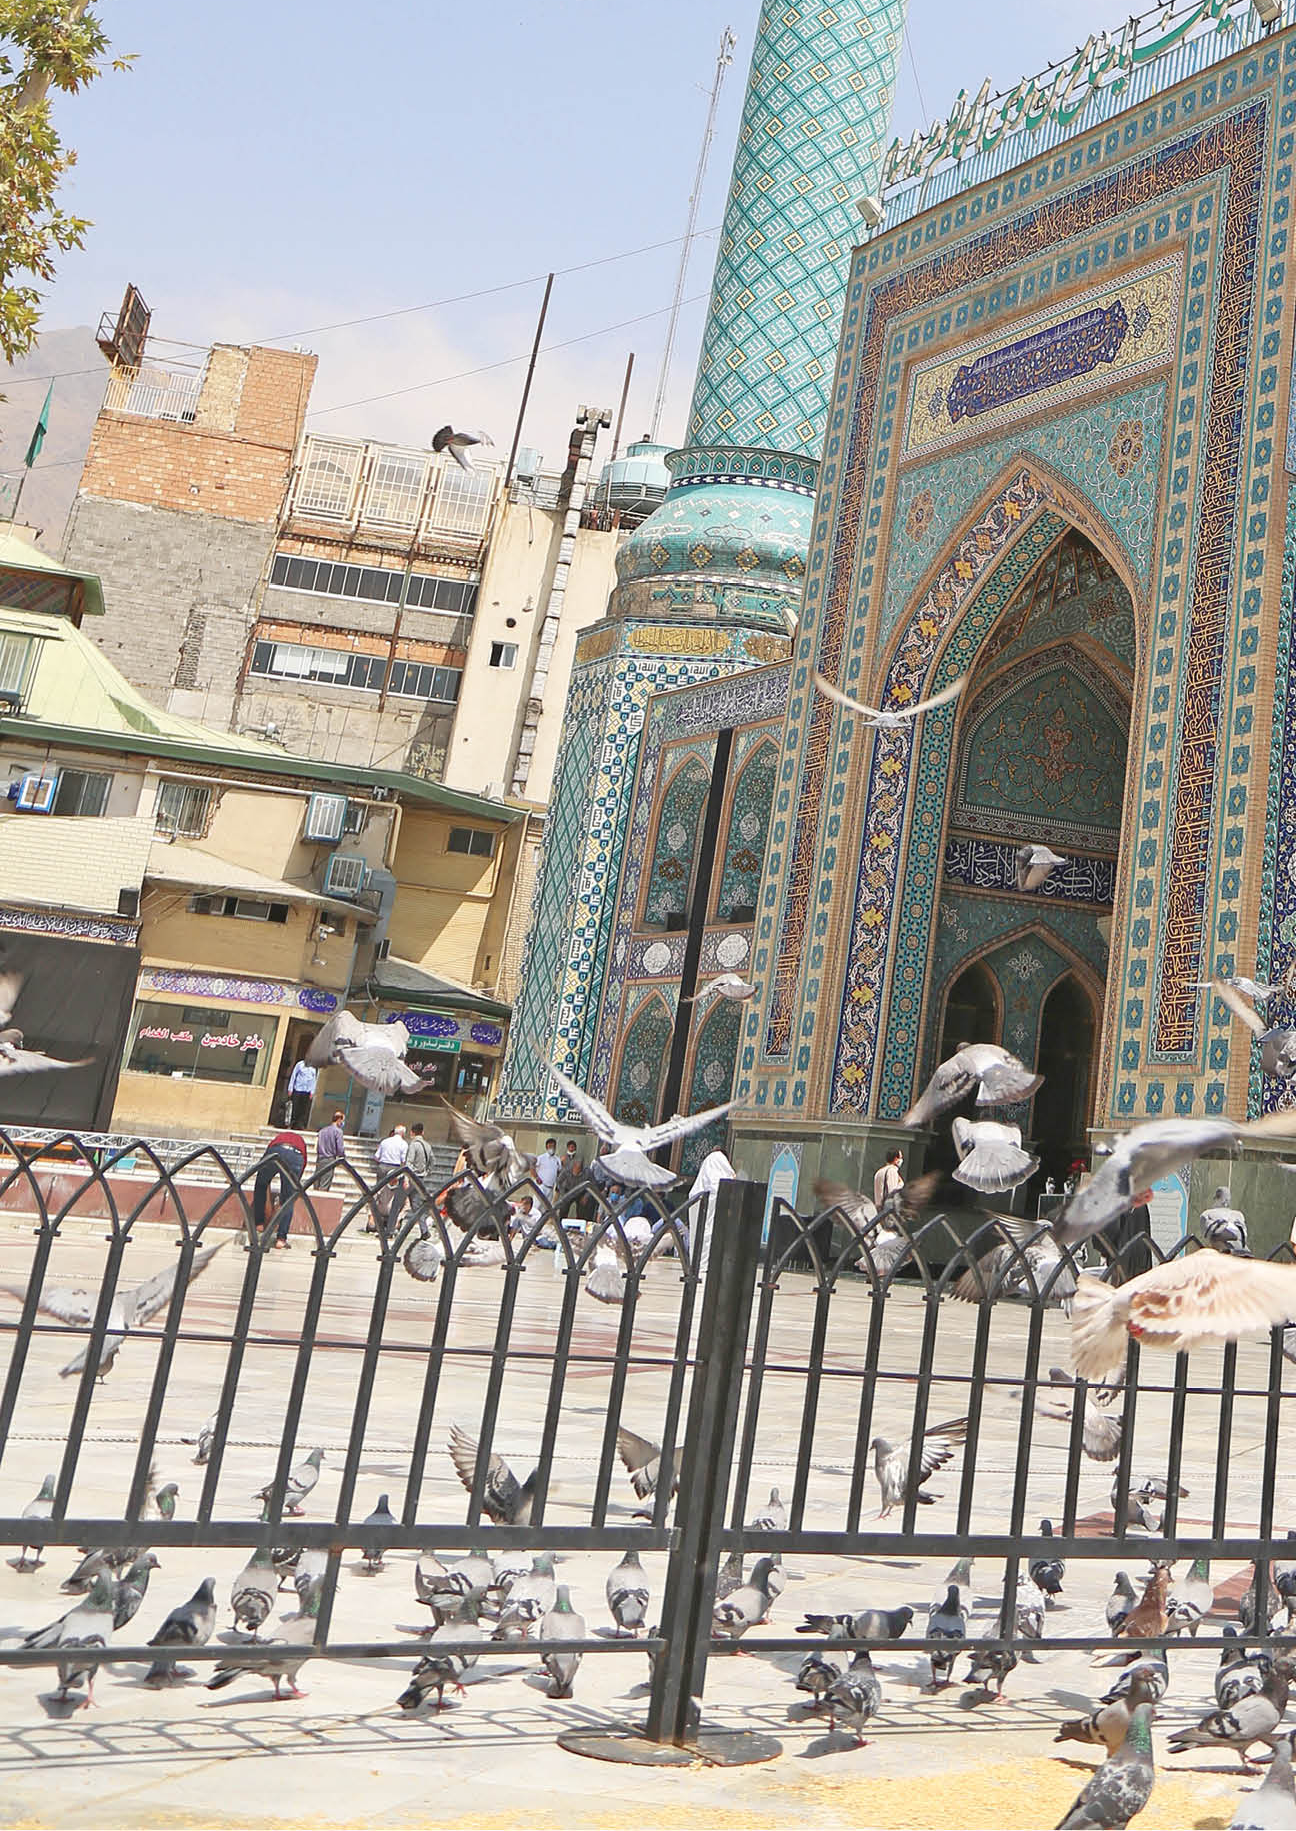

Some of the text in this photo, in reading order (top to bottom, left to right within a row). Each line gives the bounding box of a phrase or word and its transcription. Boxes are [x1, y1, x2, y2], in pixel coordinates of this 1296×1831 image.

[139, 1026, 193, 1042] مکتب الخدام
[201, 1032, 264, 1051] دفتر خادمین
